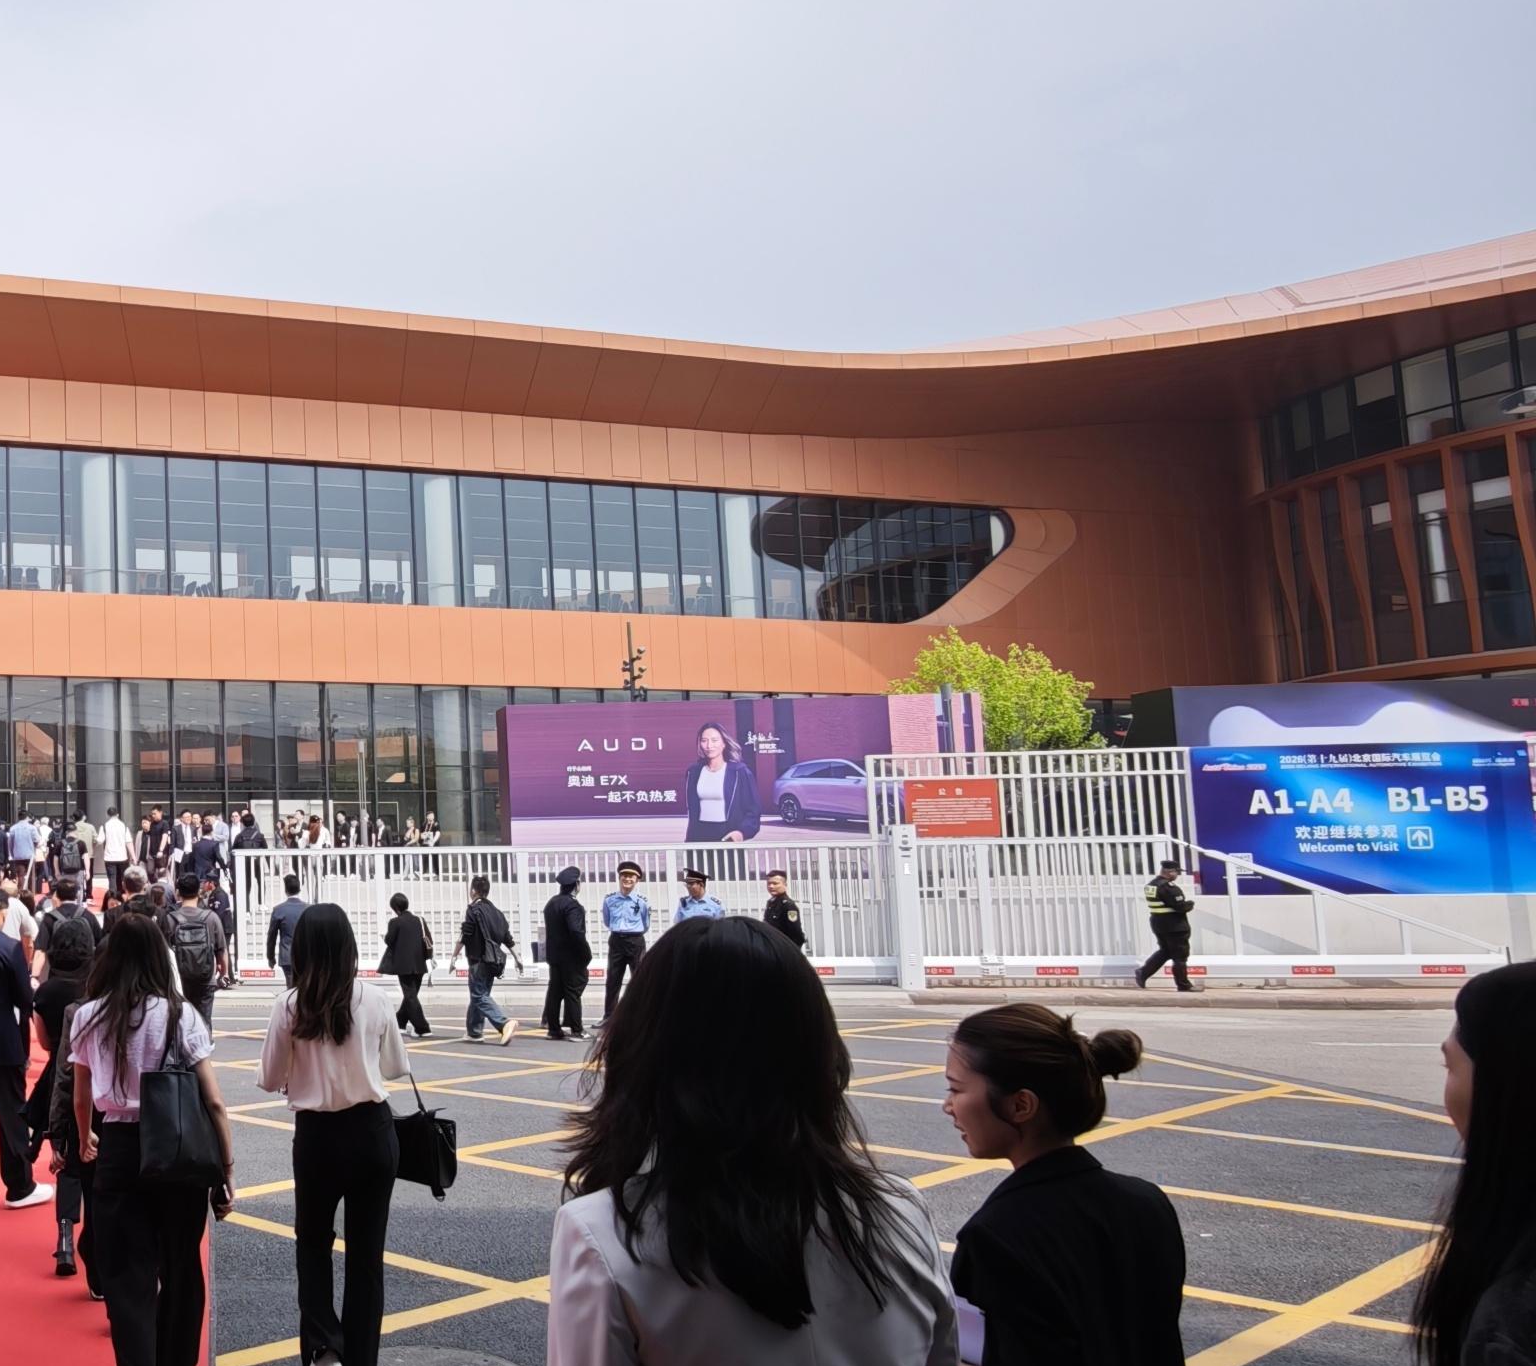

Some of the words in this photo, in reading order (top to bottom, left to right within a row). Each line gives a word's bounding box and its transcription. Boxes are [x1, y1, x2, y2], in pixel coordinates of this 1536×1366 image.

[577, 737, 663, 752] AUDI
[567, 774, 595, 787] 奥迪
[600, 774, 628, 786] E7X
[593, 790, 677, 803] 一起不负热爱
[1249, 788, 1354, 815] A1-A4
[1387, 785, 1488, 813] B1-B5
[1295, 824, 1398, 840] 欢迎继续参观
[1299, 842, 1355, 853] Welcome
[1357, 842, 1369, 852] to
[1371, 841, 1399, 852] Visit
